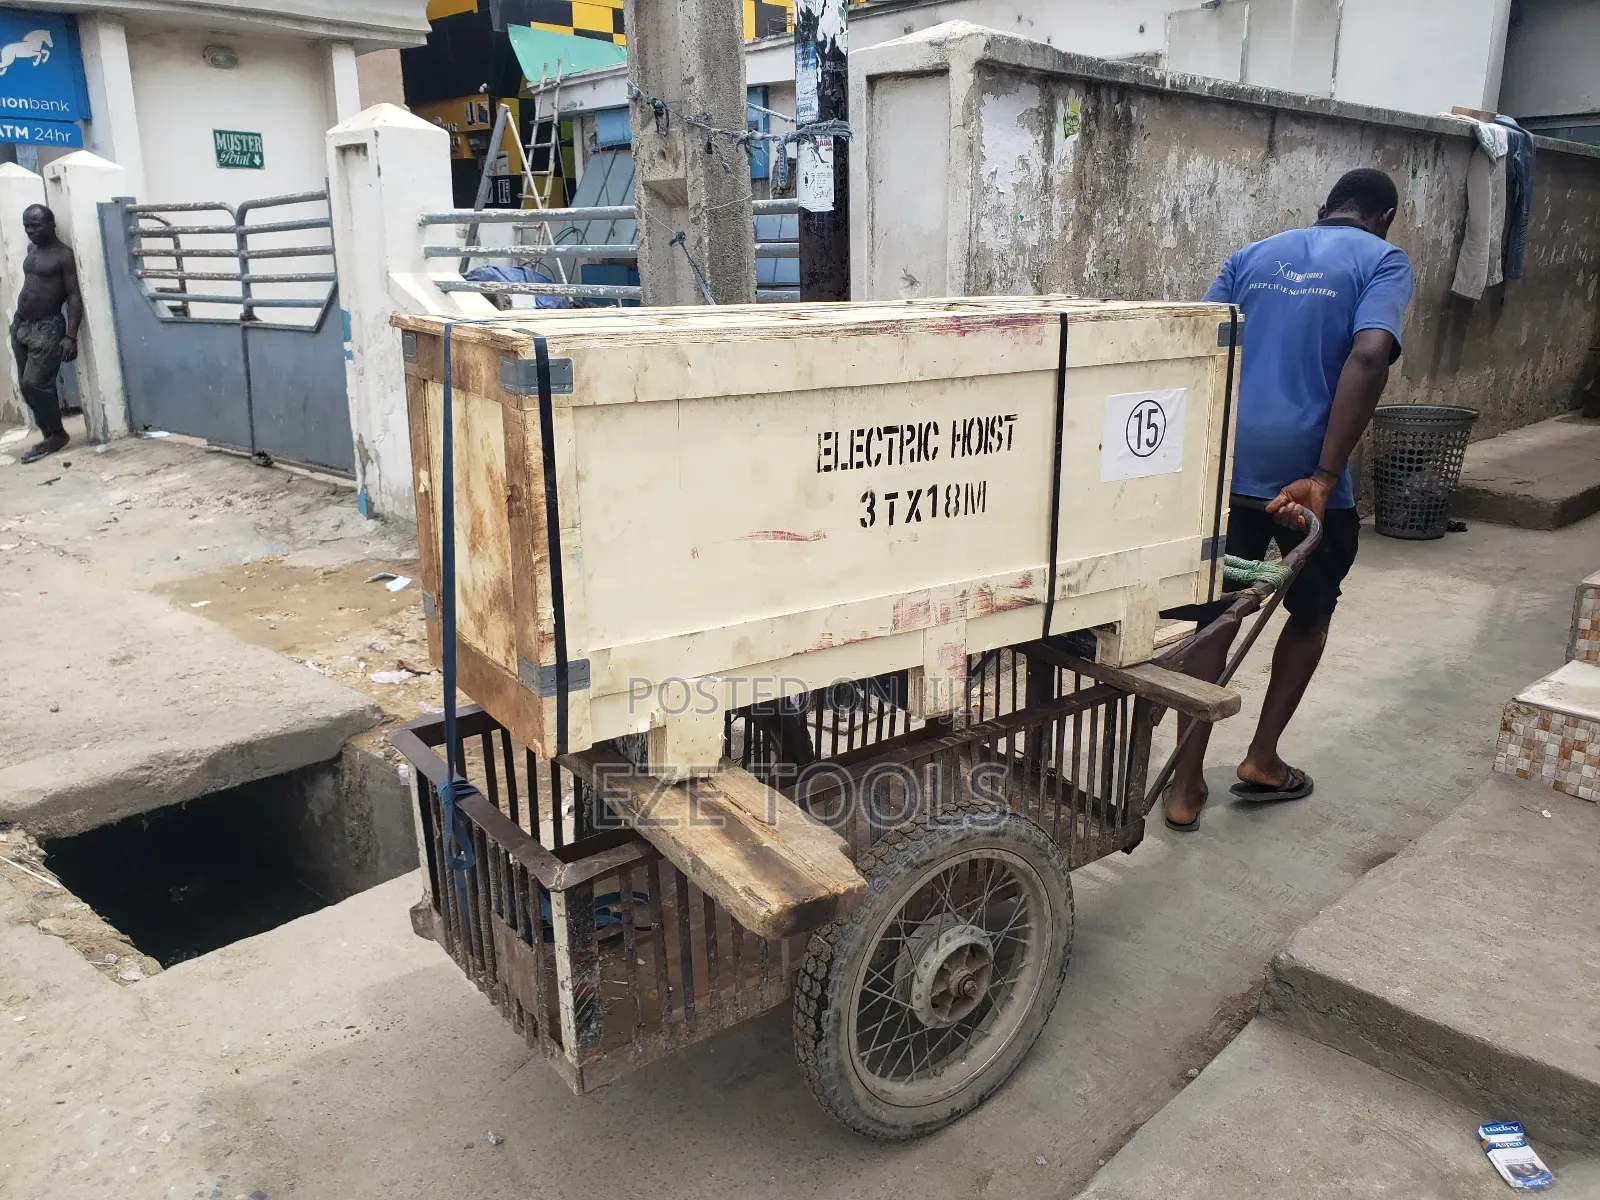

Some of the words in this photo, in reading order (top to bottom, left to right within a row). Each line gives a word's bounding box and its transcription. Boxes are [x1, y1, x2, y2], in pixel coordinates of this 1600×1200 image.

[0, 97, 70, 112] ionbank
[34, 127, 71, 142] 24hr
[215, 132, 263, 152] MUSTER
[219, 150, 251, 165] Point
[1133, 408, 1159, 450] 15
[816, 421, 940, 474] ELECTRIC
[950, 413, 1019, 459] HOIST
[859, 480, 987, 529] 3TX18M
[1484, 1124, 1520, 1133] Aspen
